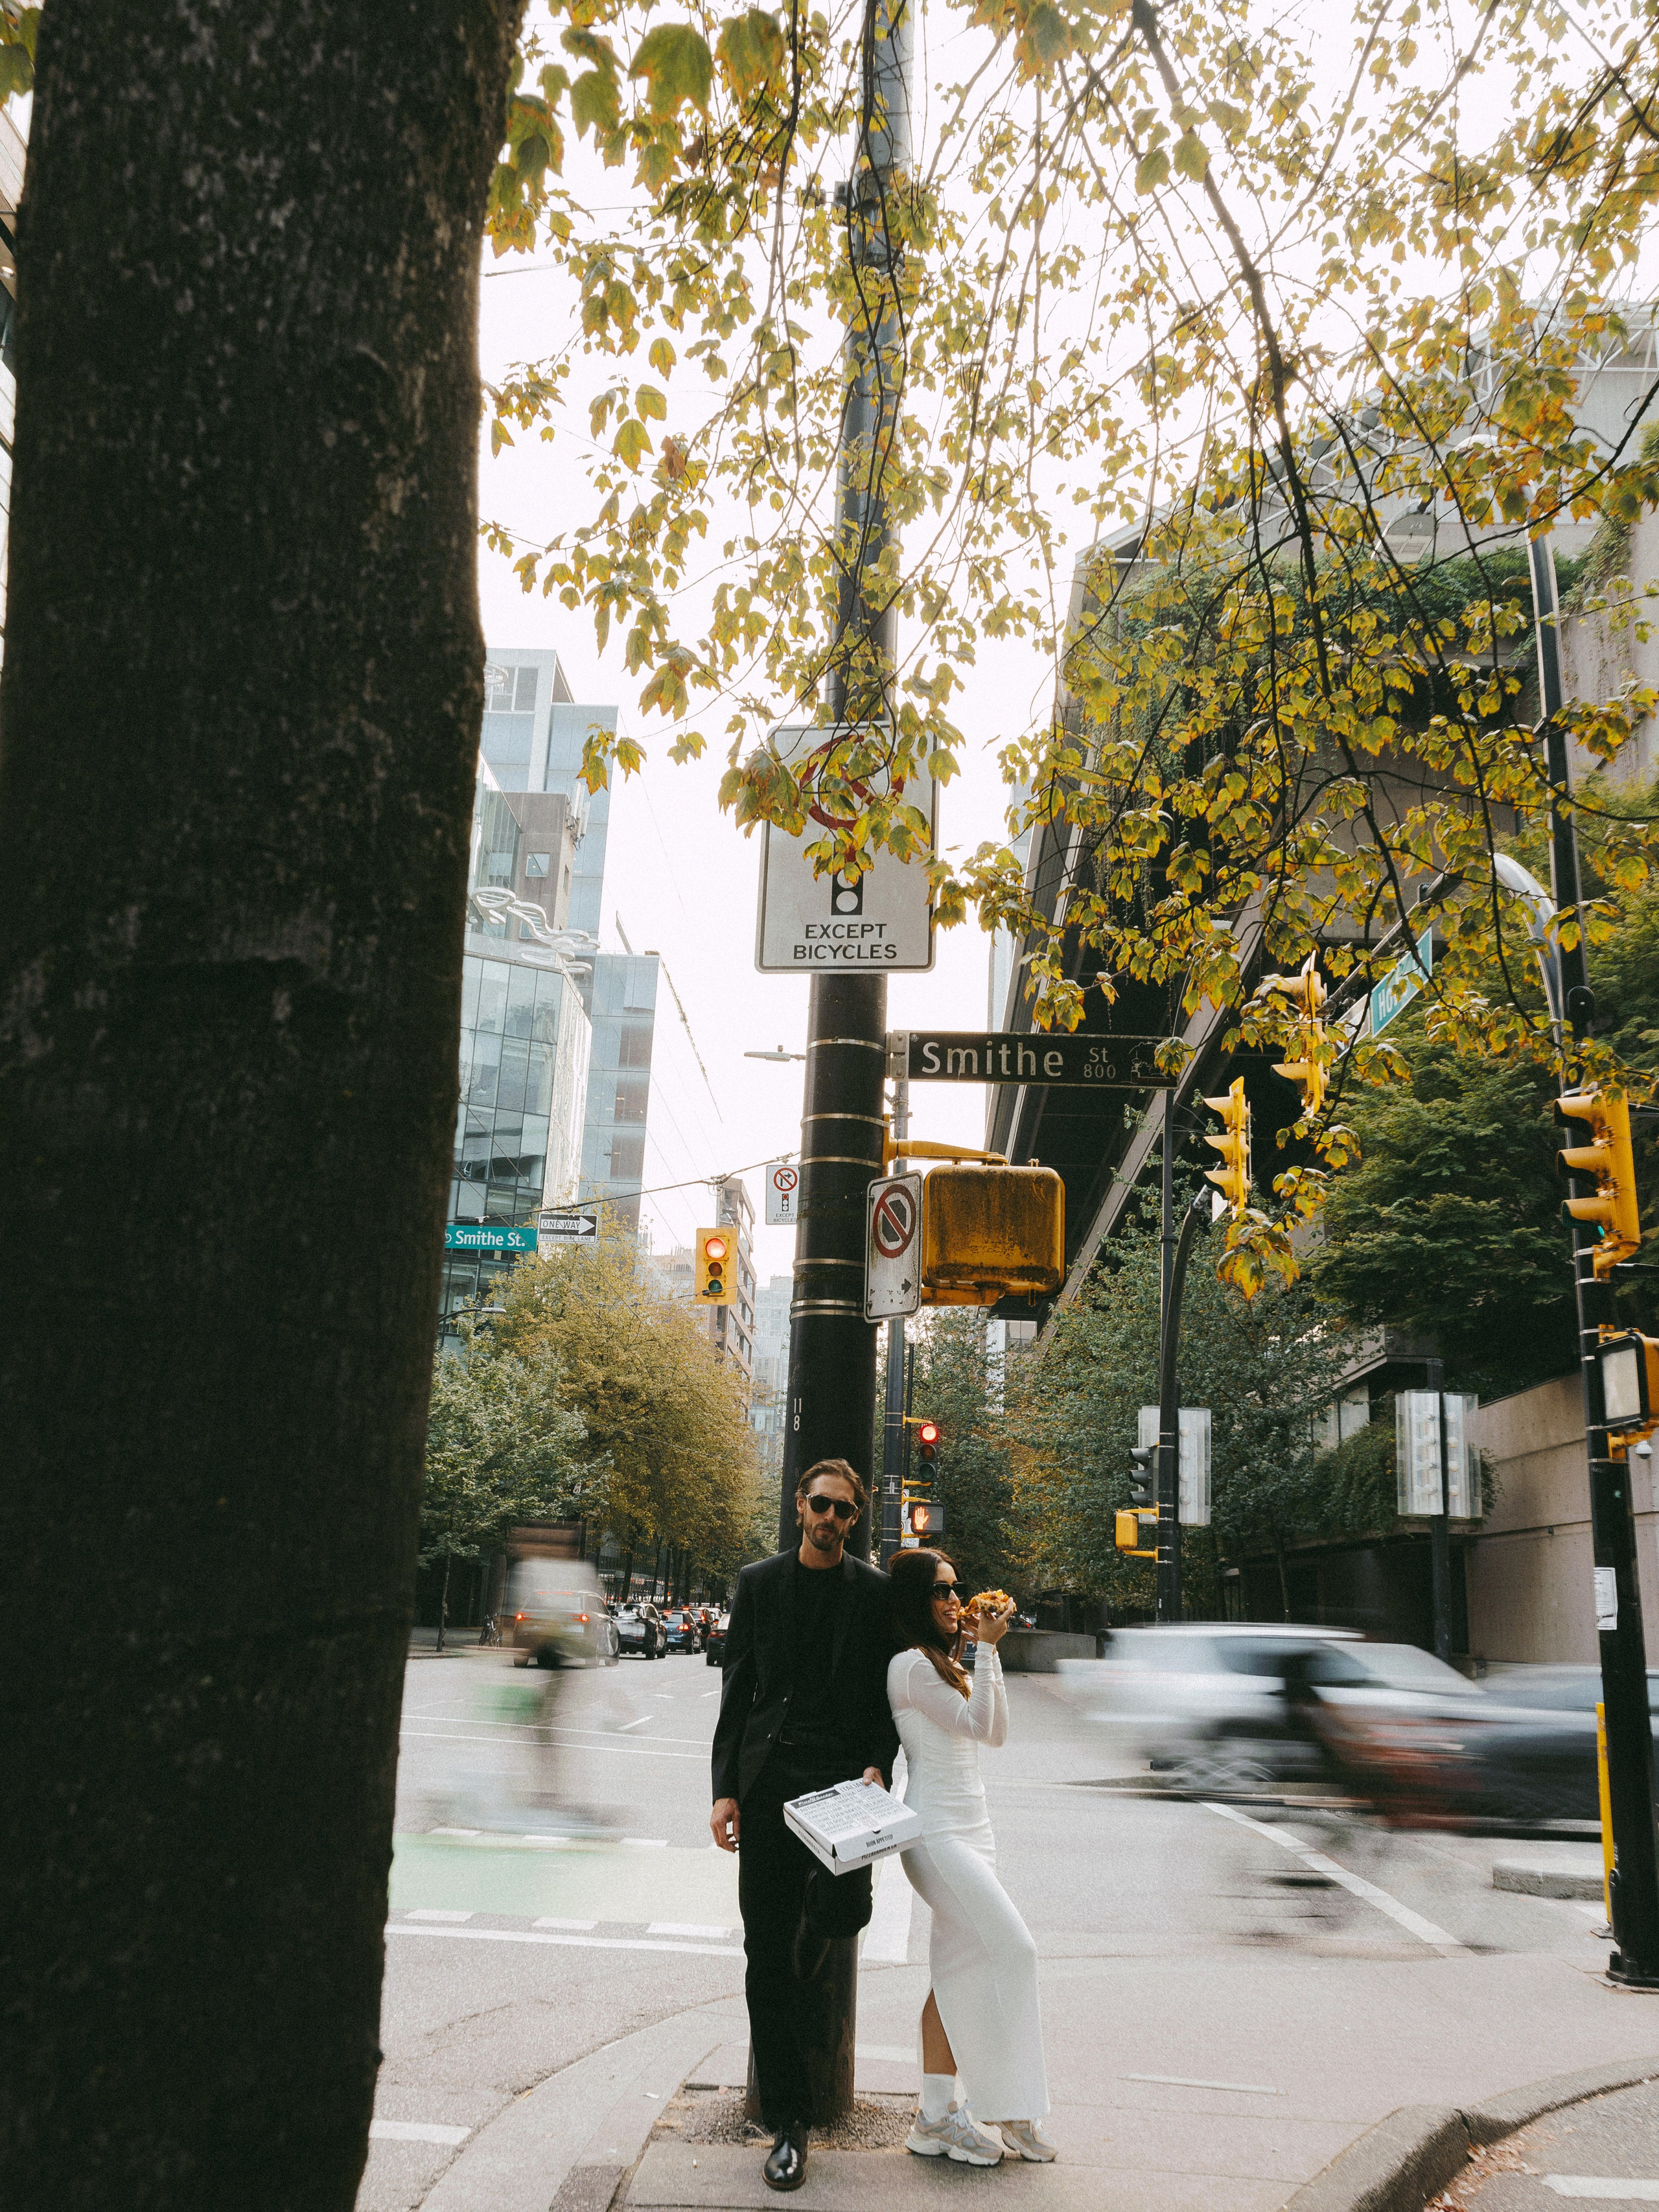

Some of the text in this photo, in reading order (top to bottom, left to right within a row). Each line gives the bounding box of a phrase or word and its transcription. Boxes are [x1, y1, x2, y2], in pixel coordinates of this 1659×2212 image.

[805, 923, 887, 939] EXCEPT
[793, 944, 898, 960] BICYCLES
[921, 1040, 1108, 1077] Smithe St
[1083, 1064, 1117, 1080] 800
[455, 1230, 526, 1247] Smithe St.
[793, 1415, 800, 1431] 8
